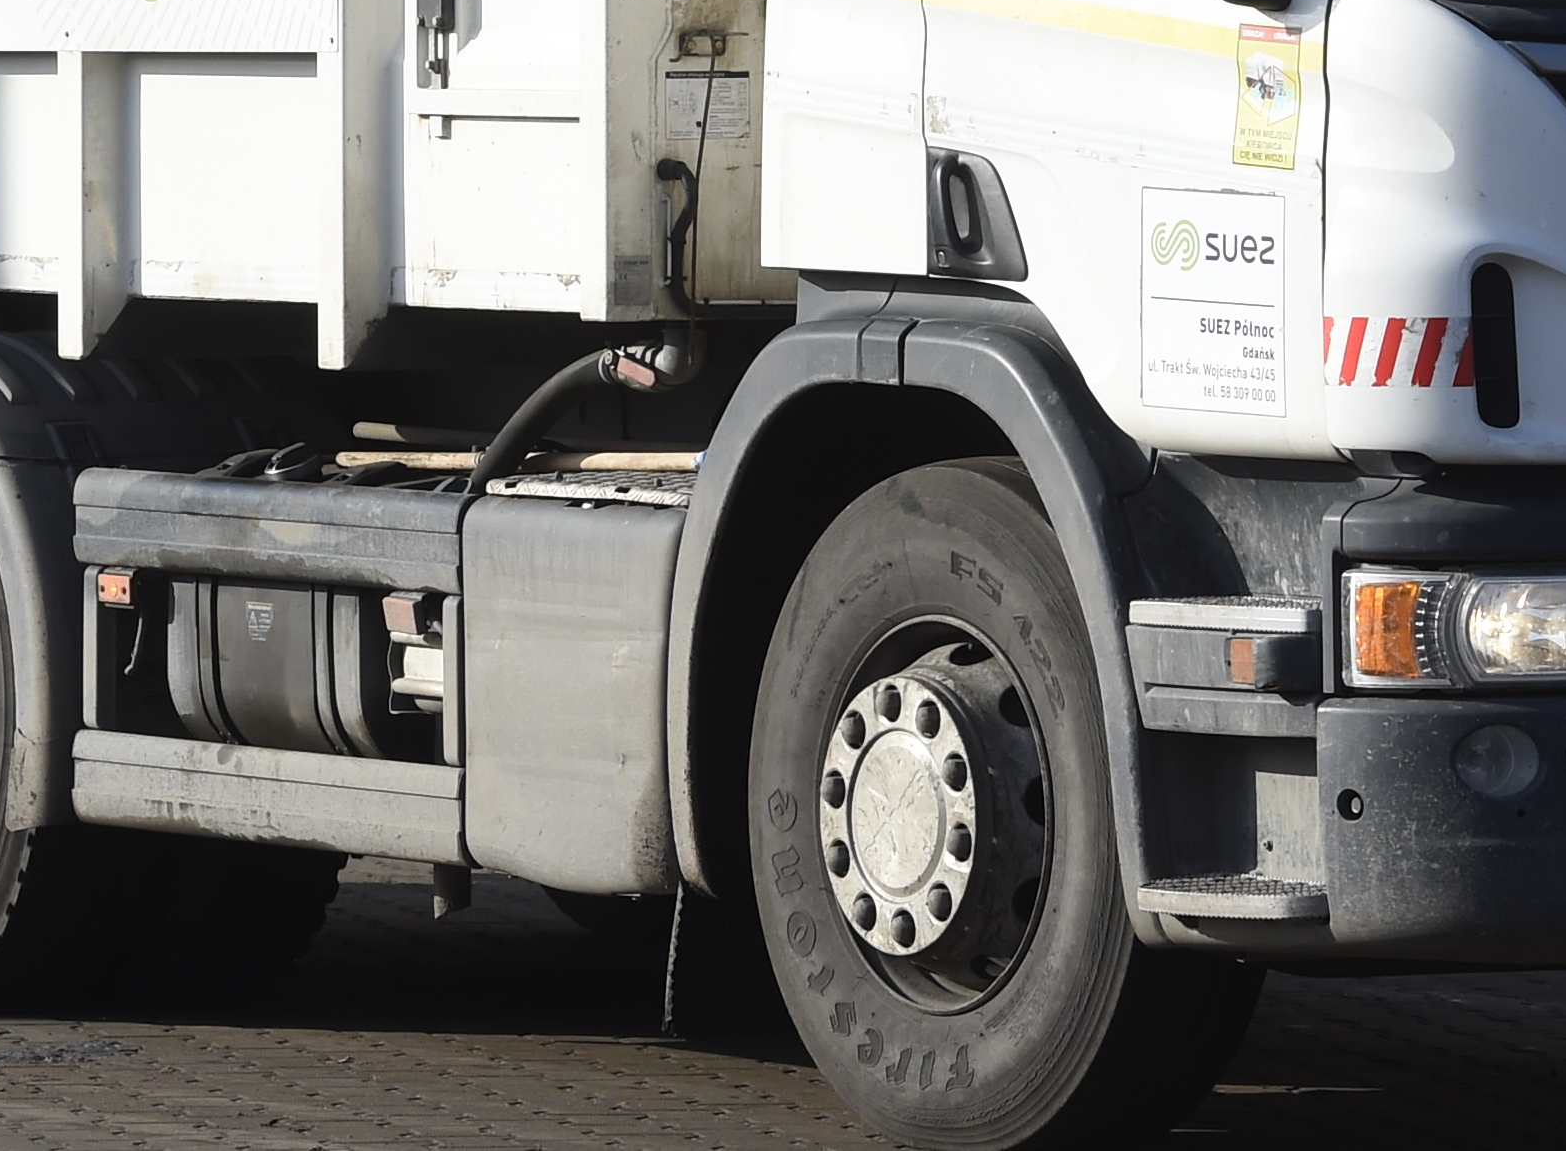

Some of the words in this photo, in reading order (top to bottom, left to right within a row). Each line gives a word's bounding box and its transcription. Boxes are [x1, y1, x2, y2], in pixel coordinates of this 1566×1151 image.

[1252, 152, 1263, 161] NIE
[1204, 232, 1275, 265] suez
[1199, 317, 1231, 335] SUEZ
[1234, 319, 1275, 338] Północ
[1242, 346, 1275, 360] Gdańsk
[1148, 360, 1159, 372] ul.
[1161, 360, 1184, 374] Trakt
[1185, 359, 1201, 375] Św.
[1203, 363, 1248, 380] Wojciecha
[1250, 367, 1275, 381] 43/45
[1204, 385, 1218, 398] tel.
[1220, 386, 1231, 399] 58
[1233, 387, 1250, 400] 309
[1252, 388, 1263, 401] 00
[1265, 389, 1276, 402] 00
[950, 550, 1004, 606] FS
